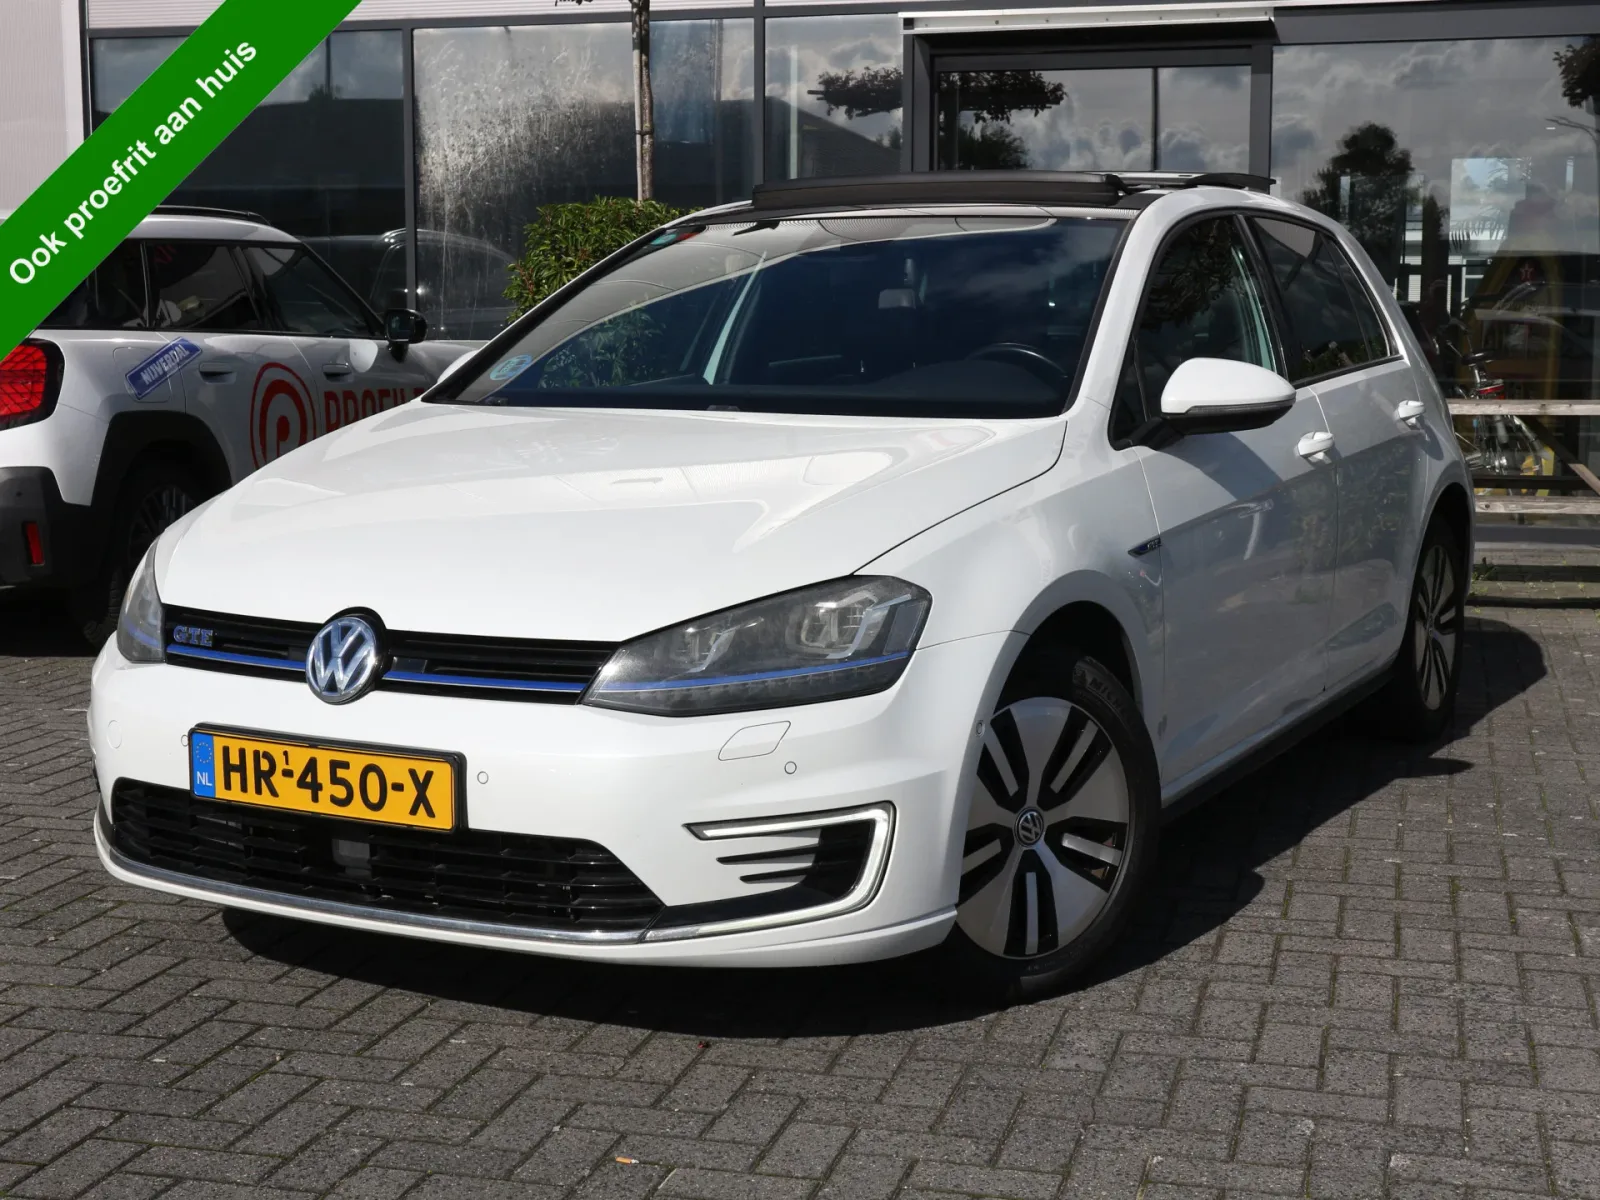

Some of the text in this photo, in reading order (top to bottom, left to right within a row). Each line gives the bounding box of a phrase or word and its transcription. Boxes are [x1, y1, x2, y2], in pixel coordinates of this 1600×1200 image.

[173, 625, 213, 647] GTE
[197, 771, 212, 787] NL
[222, 745, 435, 818] HR-450-X
